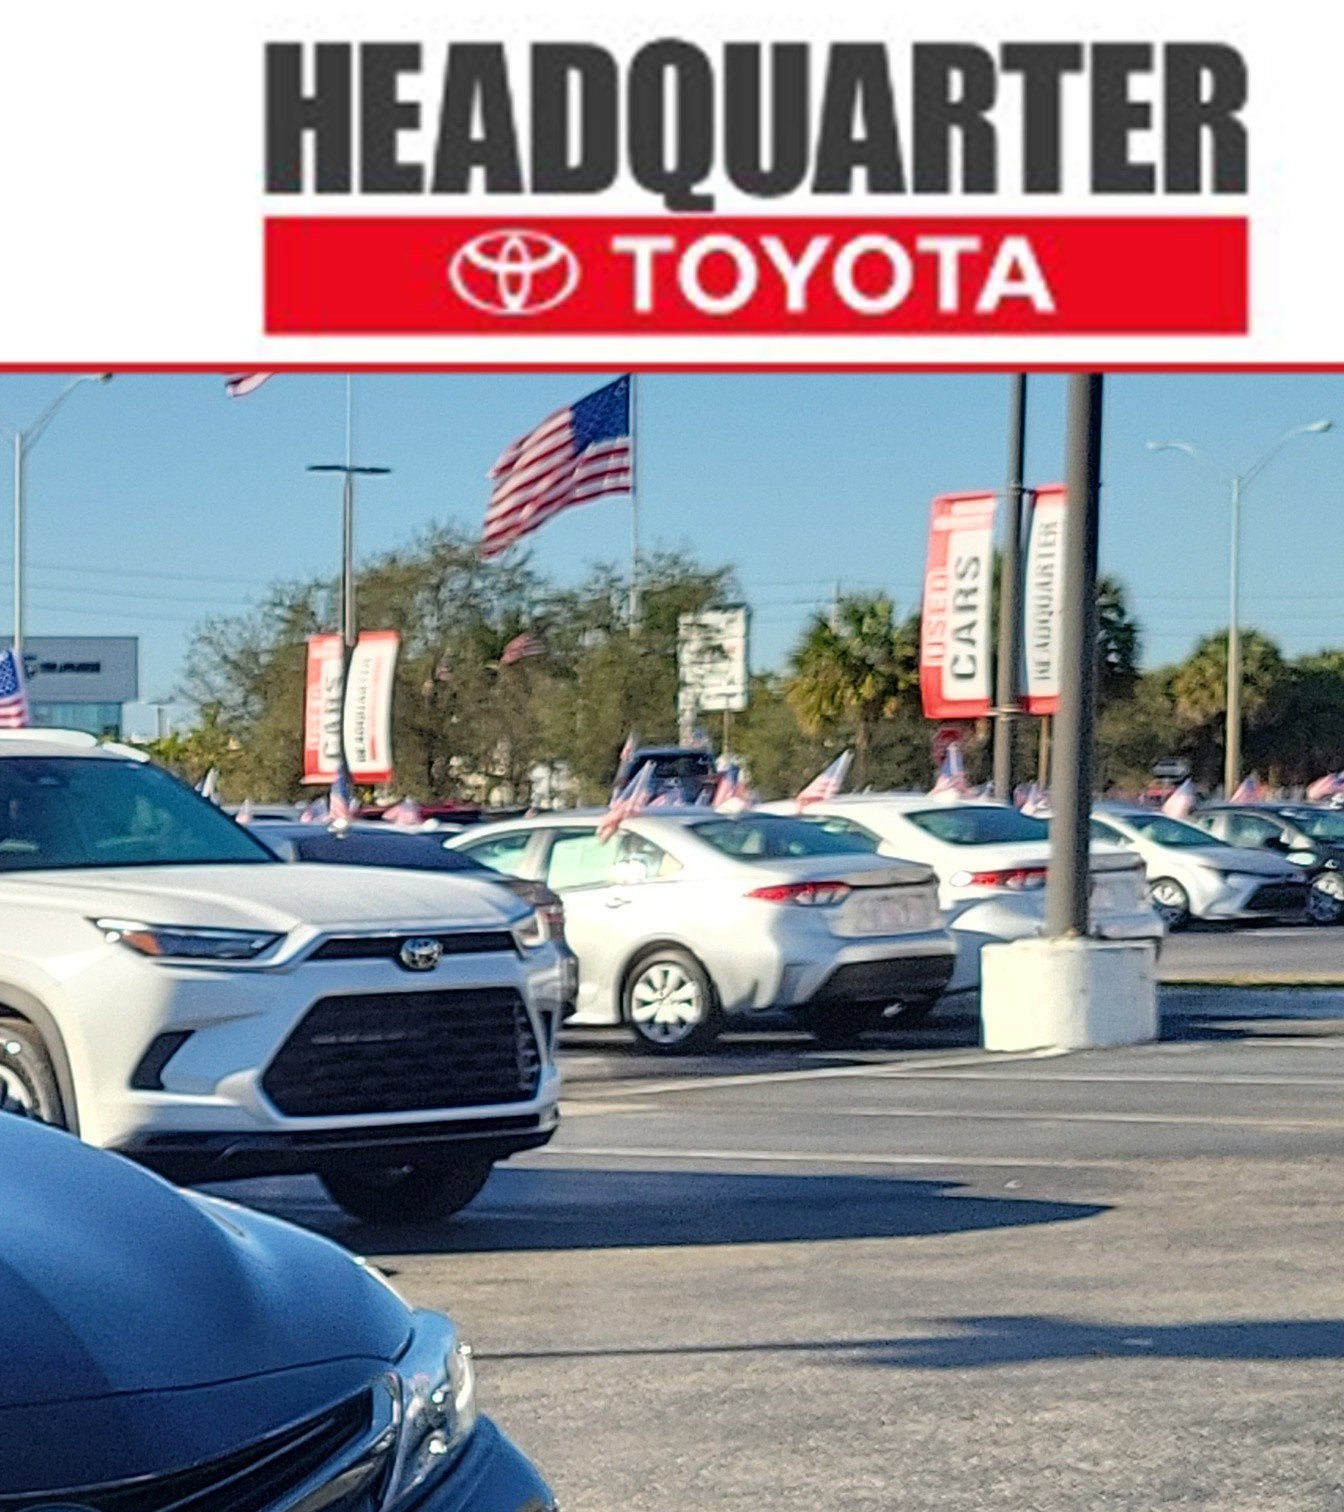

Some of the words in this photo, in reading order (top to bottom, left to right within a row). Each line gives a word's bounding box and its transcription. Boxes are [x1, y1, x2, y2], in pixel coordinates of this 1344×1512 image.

[926, 571, 949, 661] USED
[951, 555, 981, 681] CARS
[1032, 520, 1059, 681] HEADQUARTER
